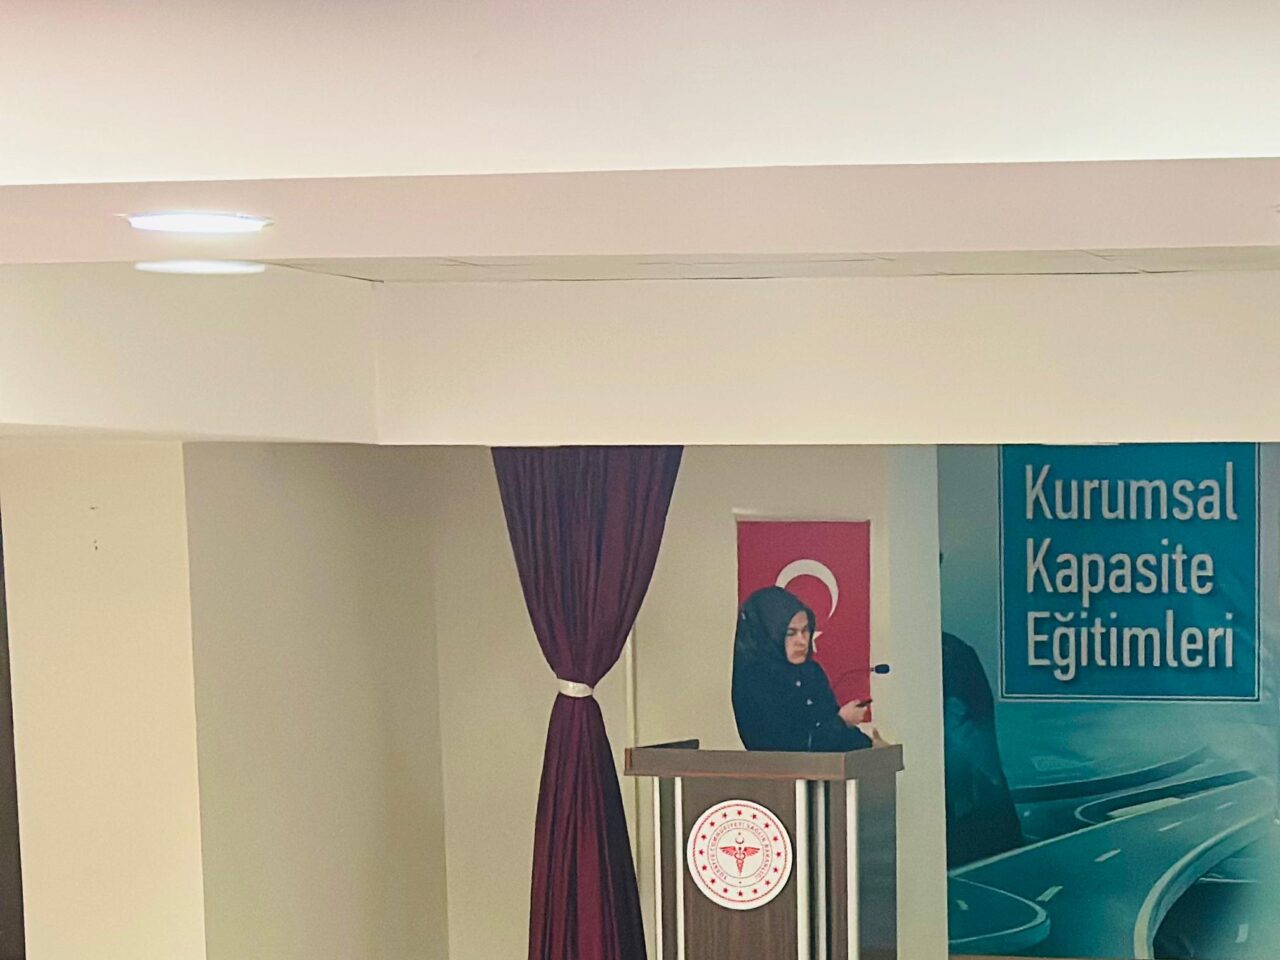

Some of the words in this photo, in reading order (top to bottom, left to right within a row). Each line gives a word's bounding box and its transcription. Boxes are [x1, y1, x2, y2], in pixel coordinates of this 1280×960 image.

[1025, 461, 1238, 520] Kurumsal
[1026, 538, 1214, 608] Kapasite
[1027, 609, 1233, 681] Eğitimleri
